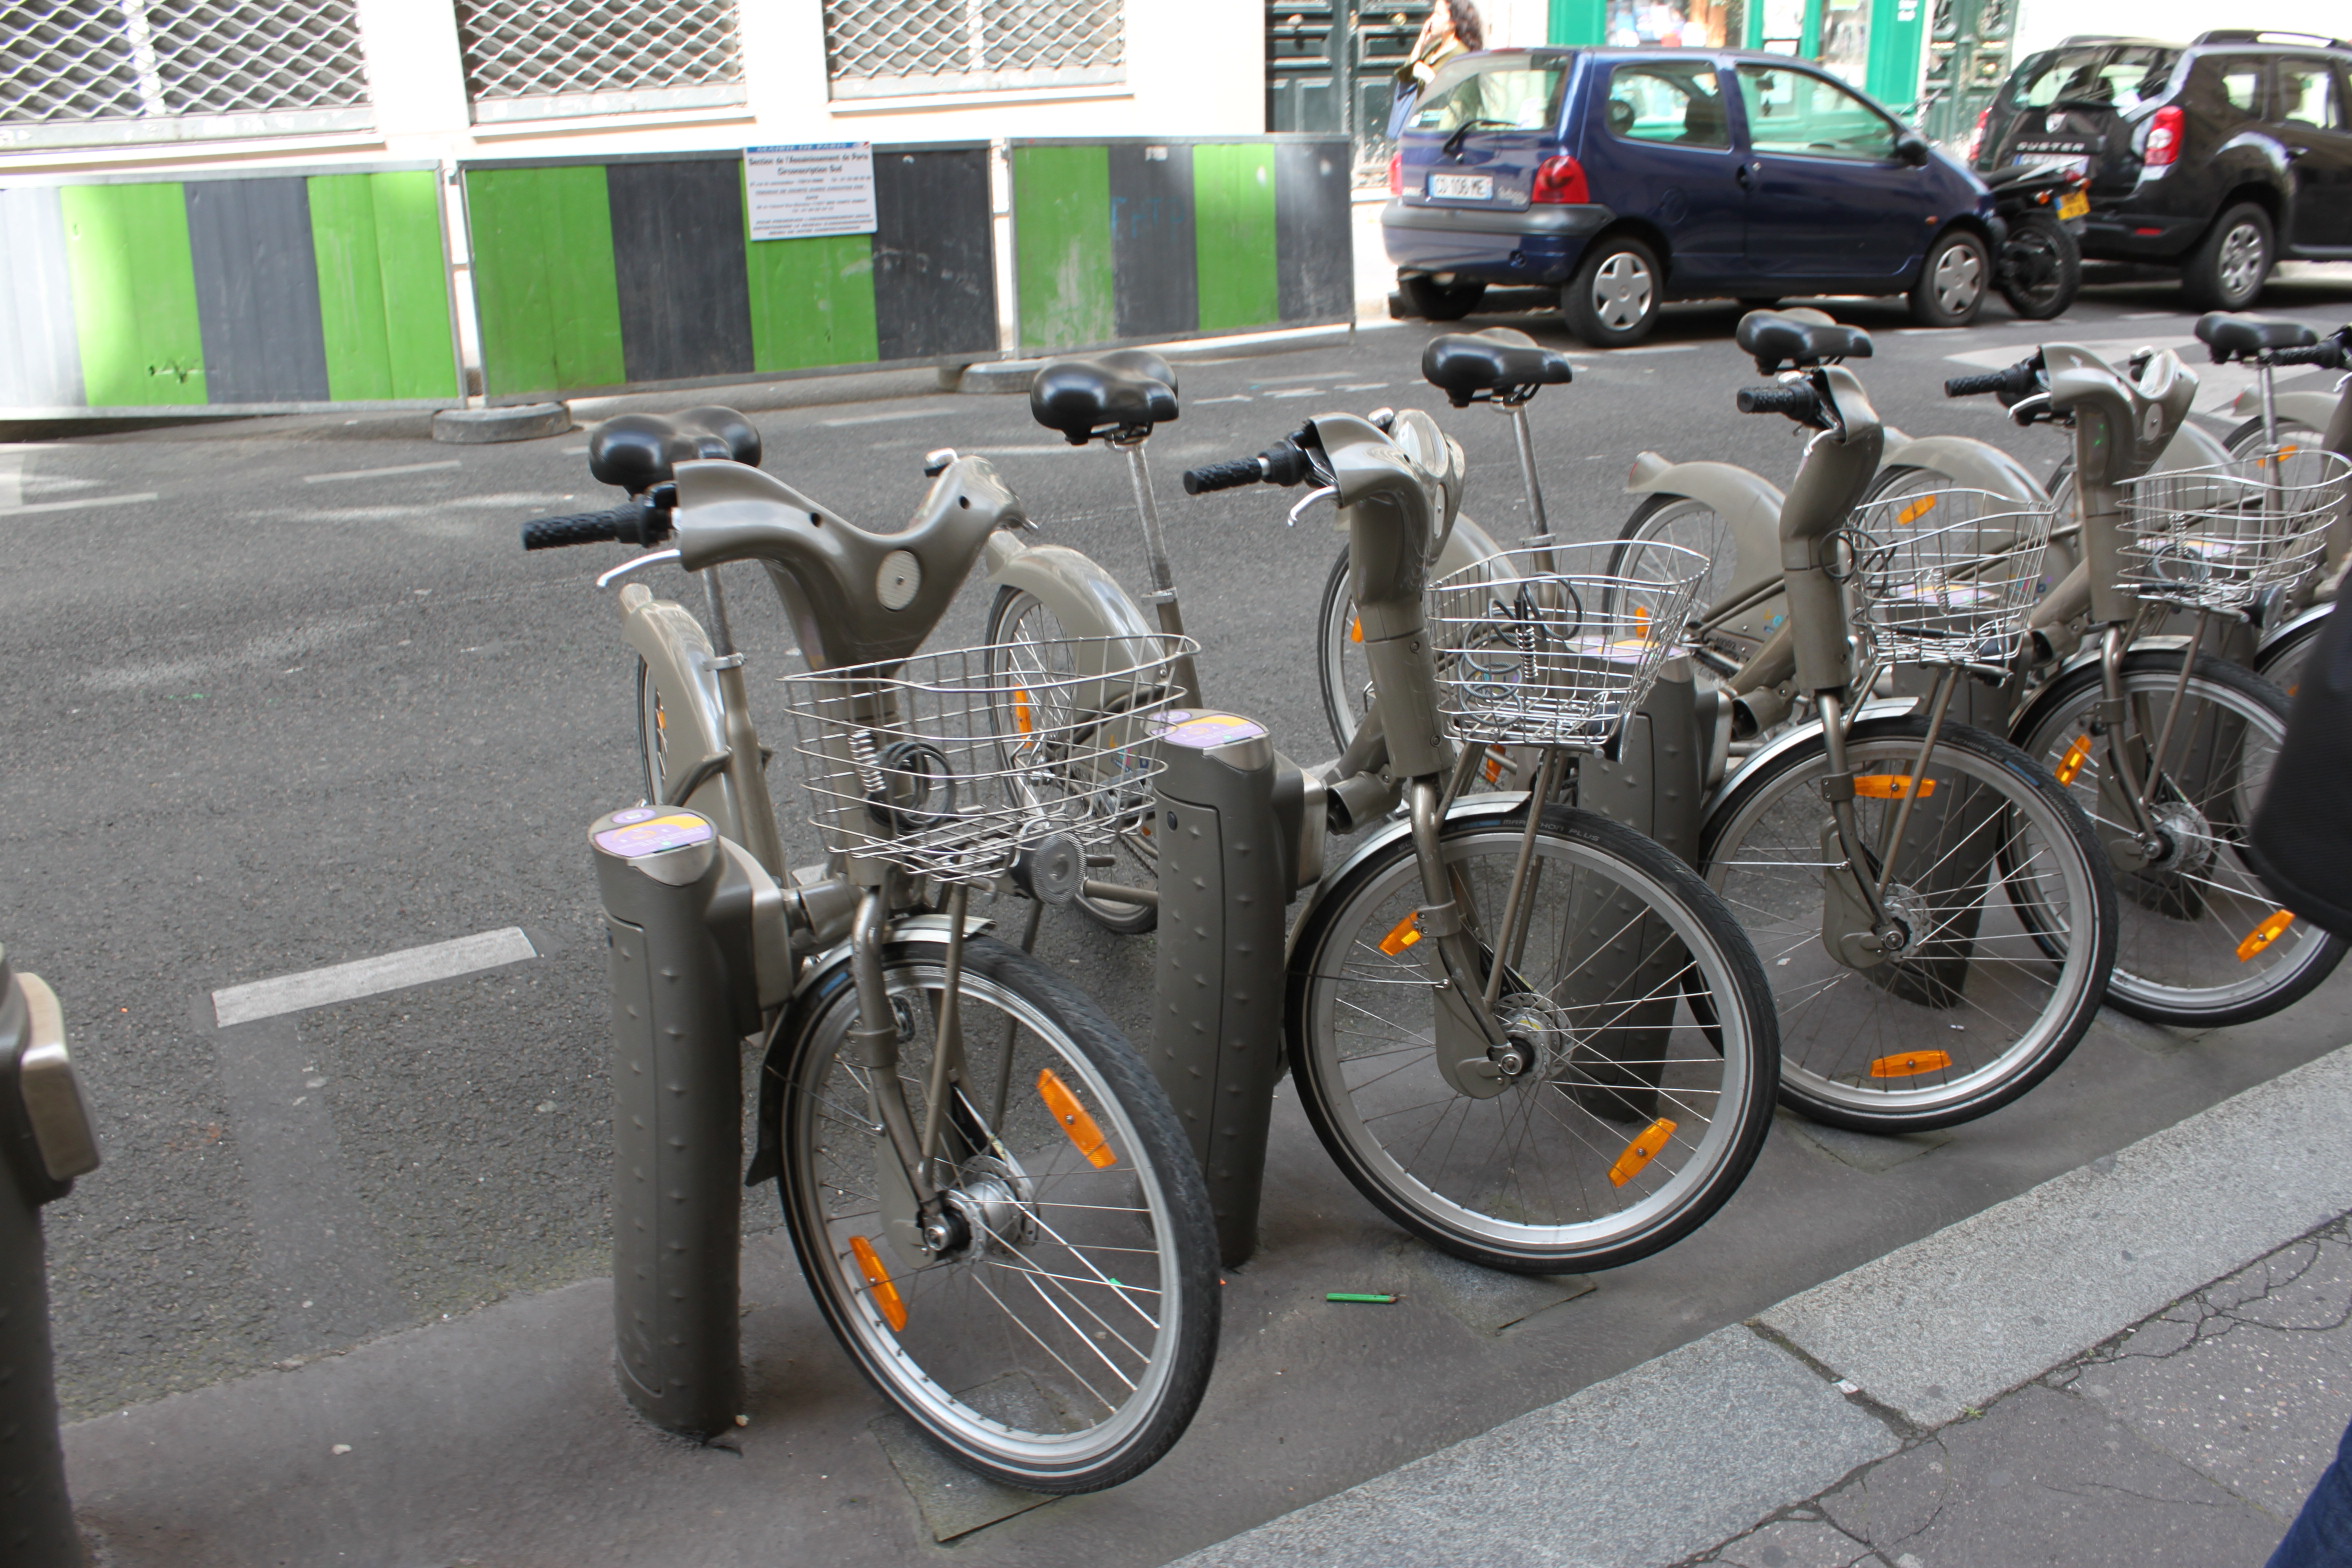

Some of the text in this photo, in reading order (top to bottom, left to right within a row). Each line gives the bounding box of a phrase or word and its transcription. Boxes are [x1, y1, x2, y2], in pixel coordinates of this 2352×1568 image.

[2016, 141, 2085, 152] DUSTER
[748, 156, 774, 166] Section
[851, 151, 869, 161] Paris
[777, 164, 843, 176] Circonscription Sud
[1502, 819, 1601, 842] MARHON PLUS
